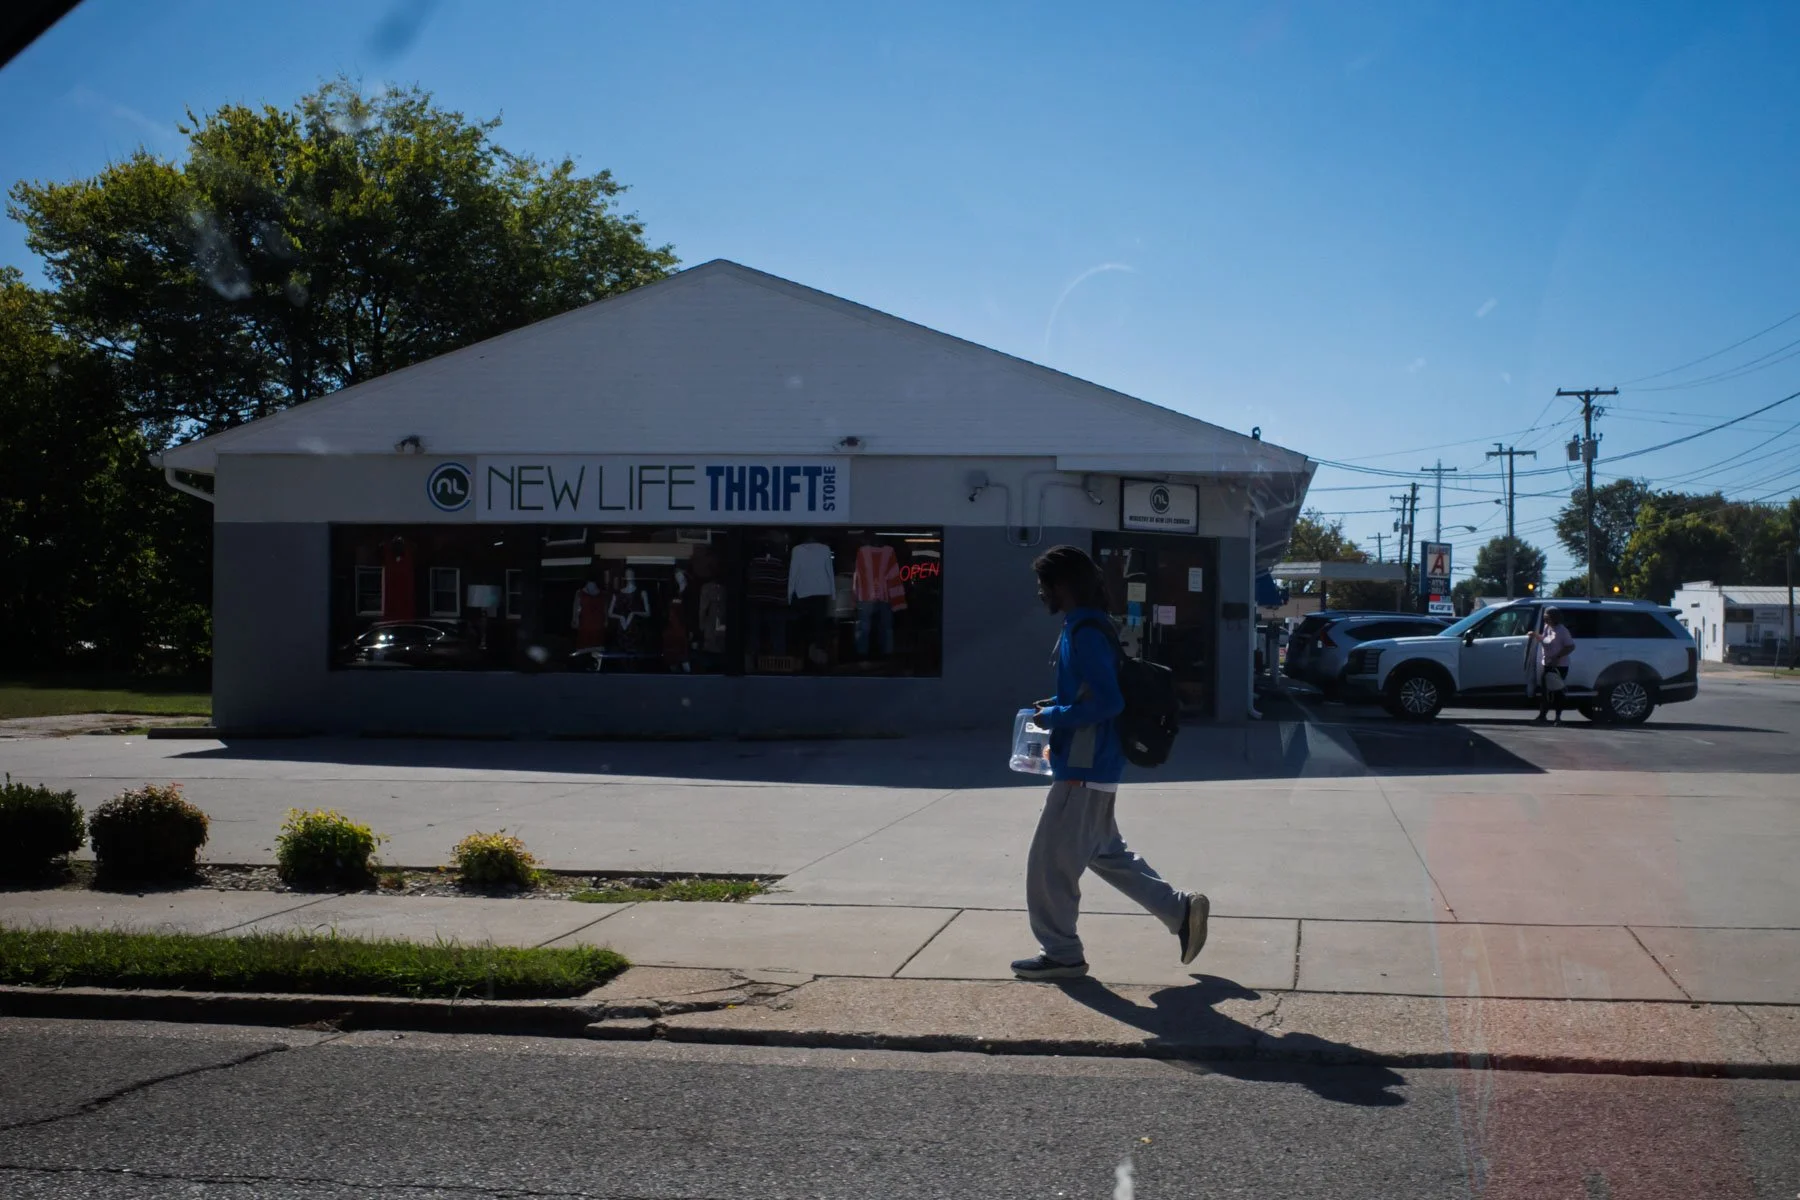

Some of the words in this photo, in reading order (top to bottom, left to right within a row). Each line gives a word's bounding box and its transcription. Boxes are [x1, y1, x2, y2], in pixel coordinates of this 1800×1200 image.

[487, 465, 585, 511] NEW
[599, 465, 695, 511] LIFE
[705, 465, 822, 511] THRIFT
[822, 465, 836, 512] STORE
[899, 562, 941, 582] OPEN
[1431, 553, 1444, 575] A
